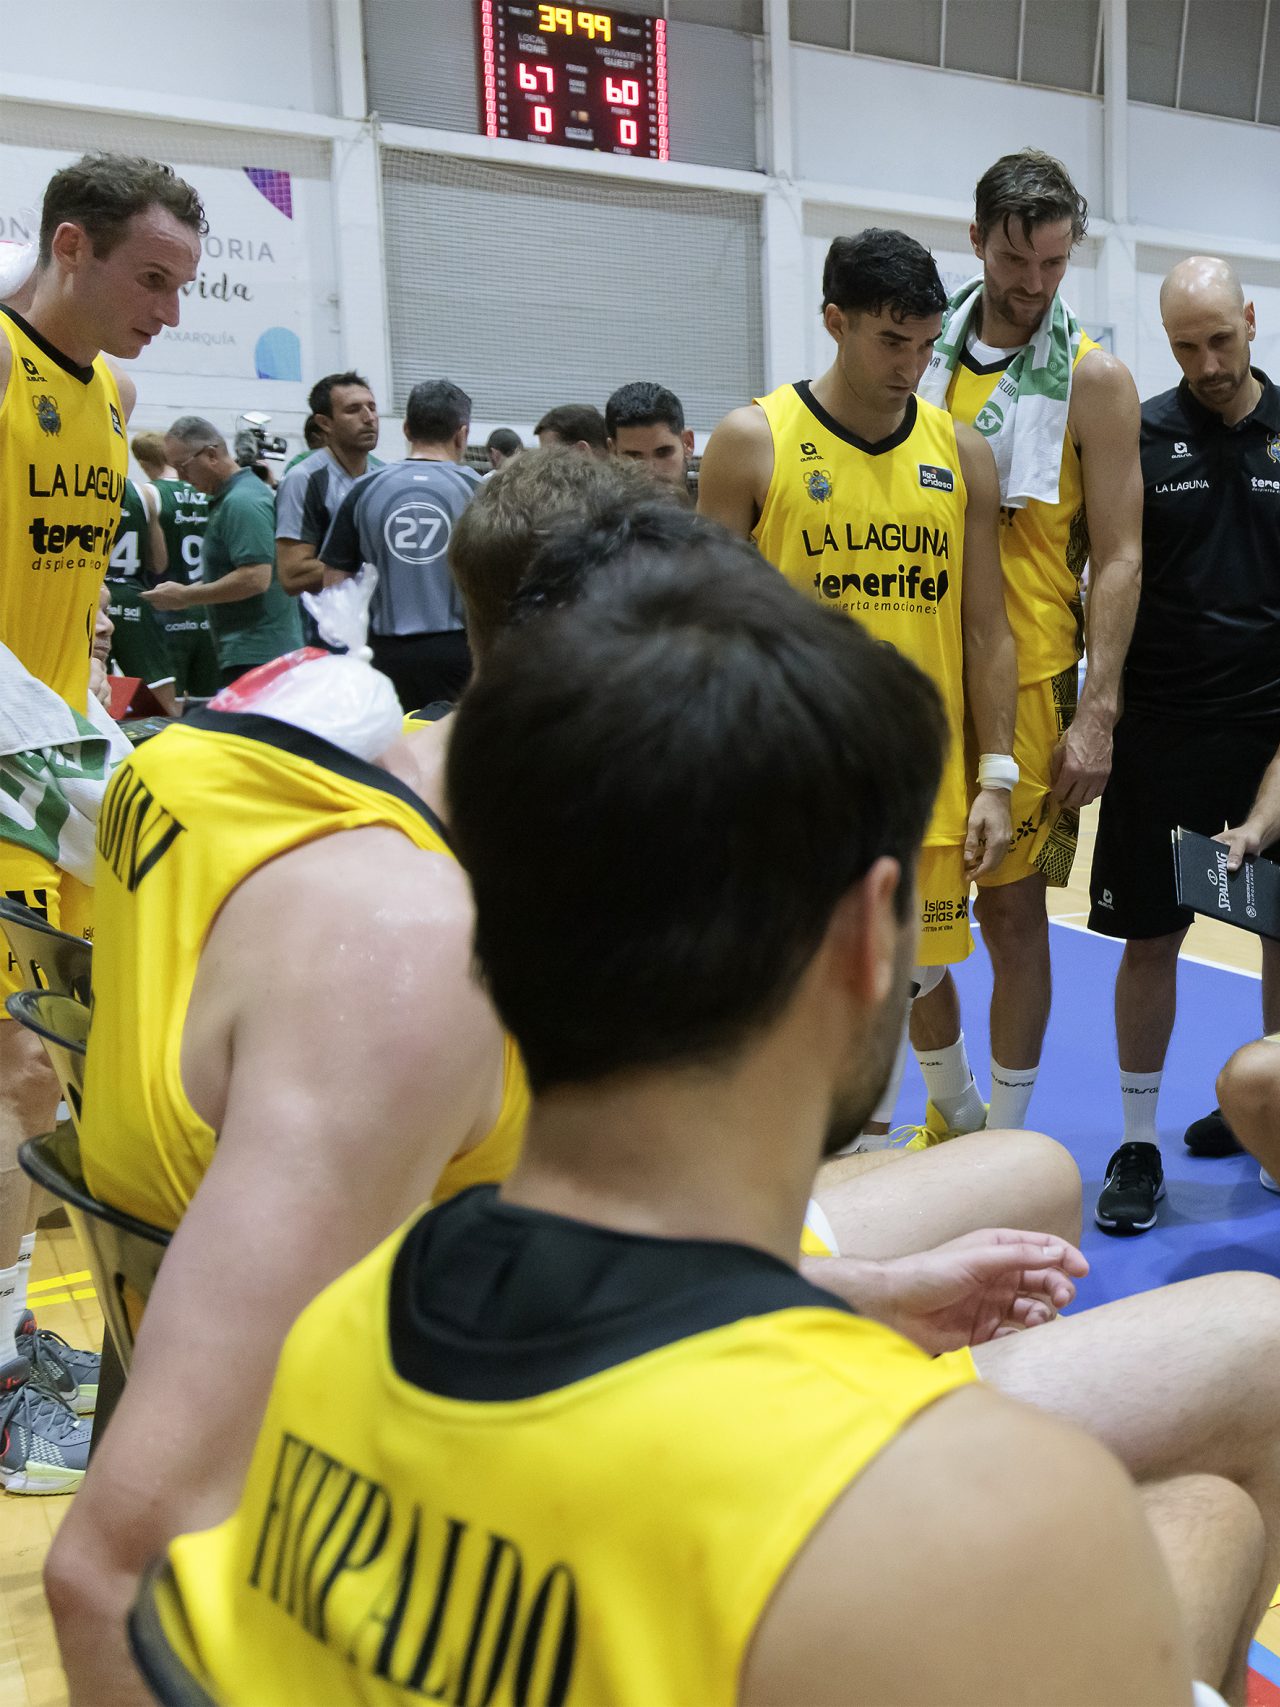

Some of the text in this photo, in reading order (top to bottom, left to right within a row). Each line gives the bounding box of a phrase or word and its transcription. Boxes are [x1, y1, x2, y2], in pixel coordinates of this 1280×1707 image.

[519, 62, 554, 93] 67
[605, 77, 640, 106] 60
[204, 237, 276, 263] ORIA
[29, 463, 69, 498] LA
[921, 470, 937, 480] liga
[922, 477, 952, 490] endesa
[1155, 479, 1210, 494] LA LAGUNA
[394, 516, 442, 549] 27
[802, 522, 949, 559] LA LAGUNA
[874, 600, 938, 615] emociones
[924, 899, 954, 912] Islas
[922, 911, 954, 923] arias
